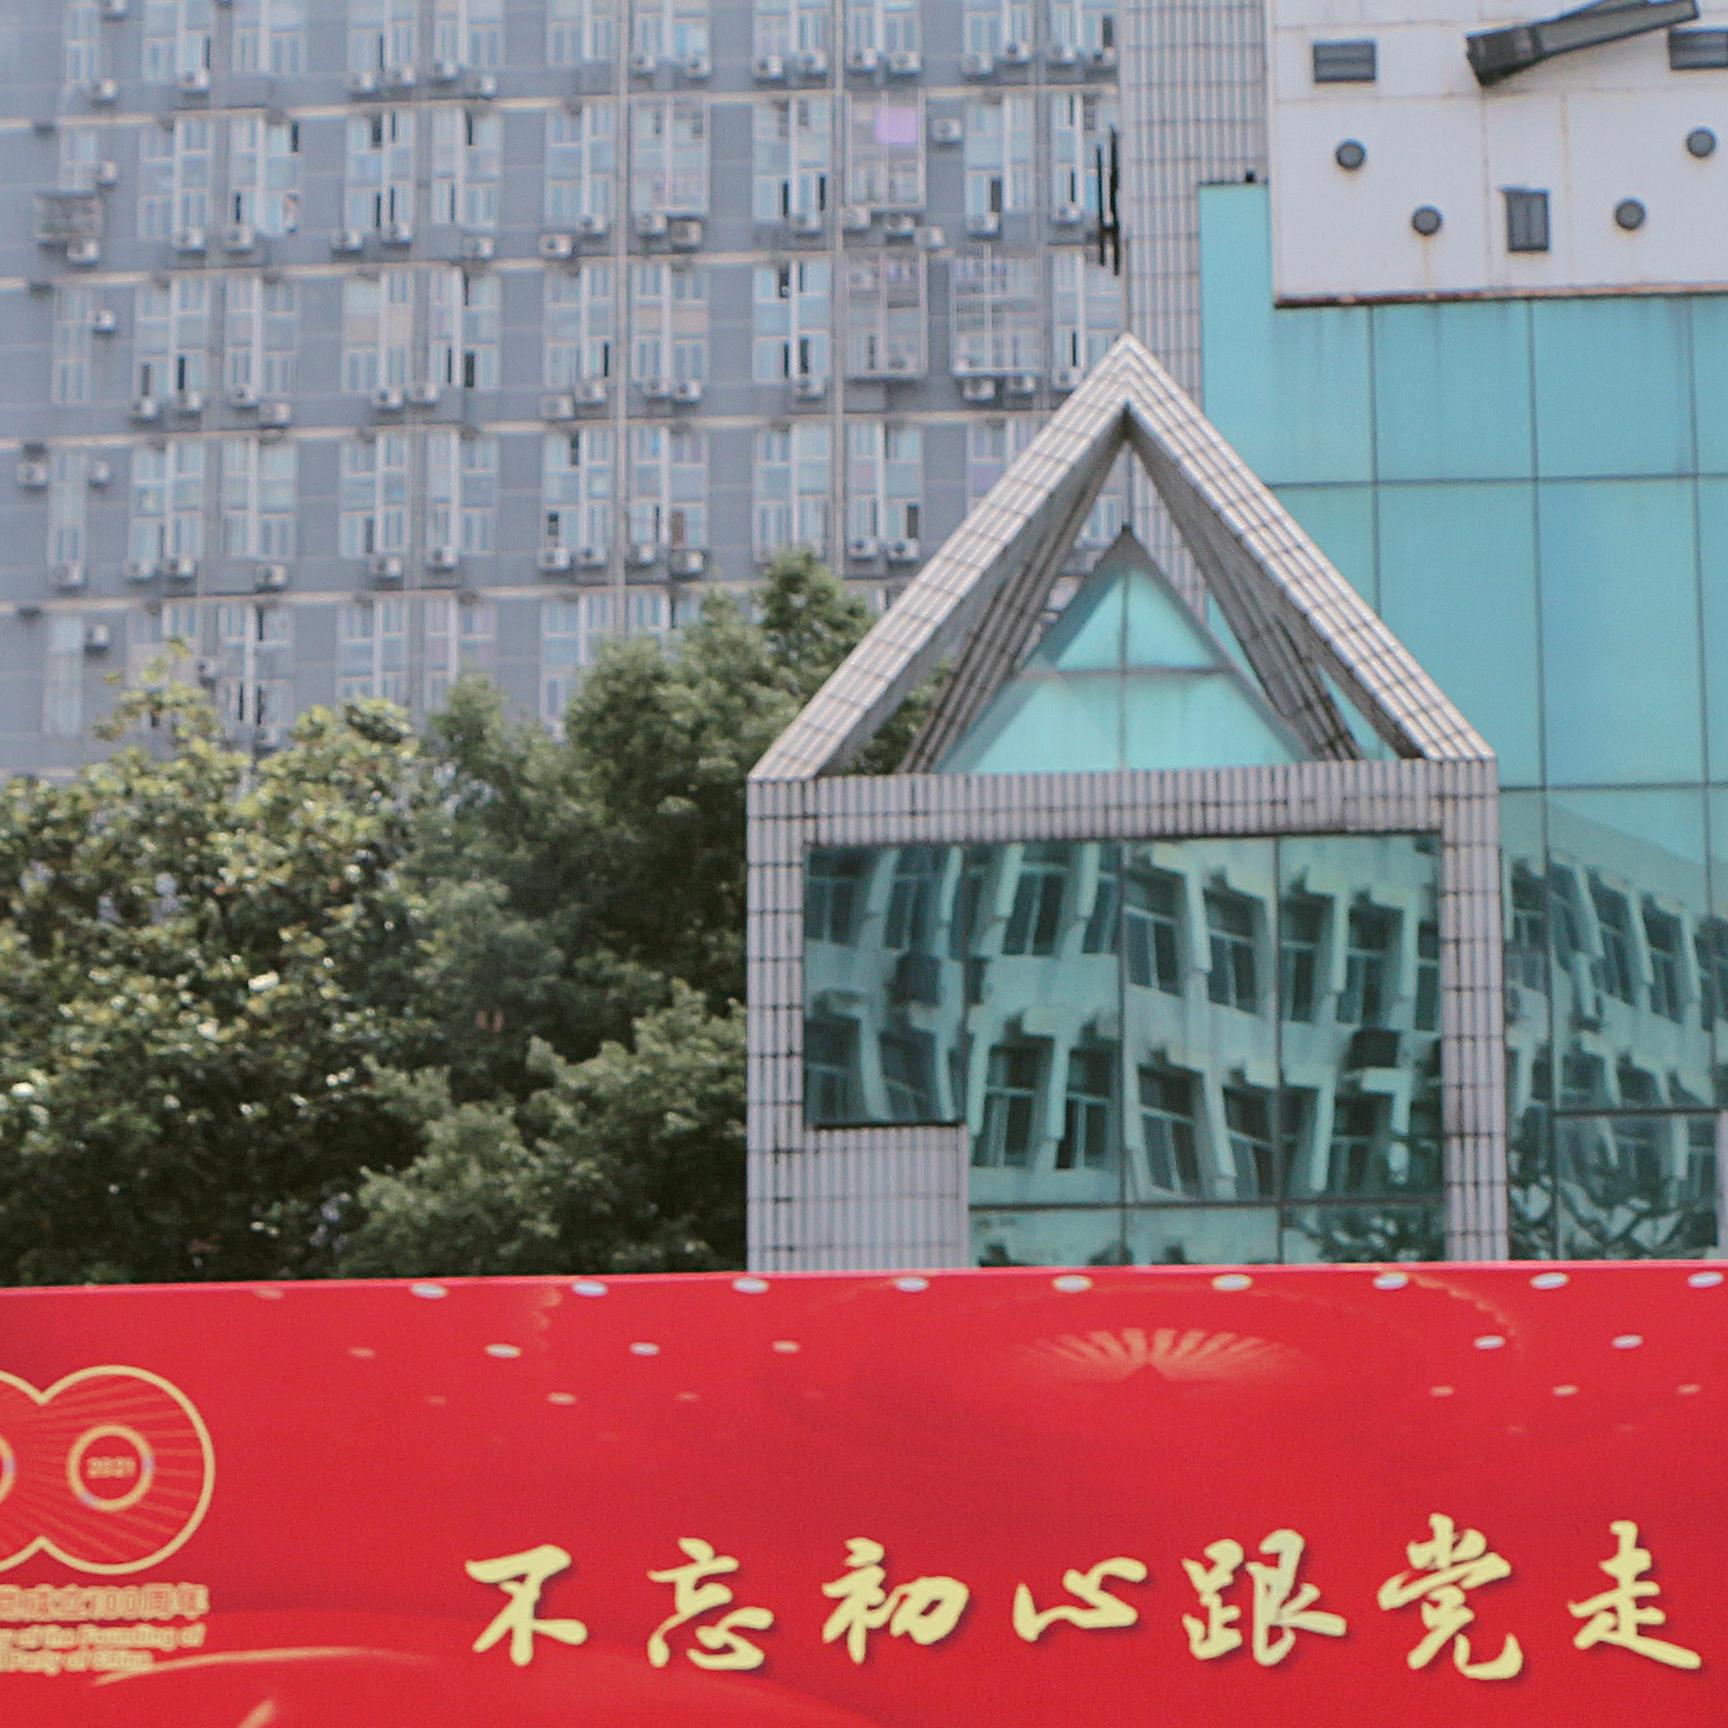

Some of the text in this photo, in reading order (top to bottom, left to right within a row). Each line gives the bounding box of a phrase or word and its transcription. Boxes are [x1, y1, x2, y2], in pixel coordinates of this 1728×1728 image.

[465, 1512, 1702, 1680] 不忘初心跟党走
